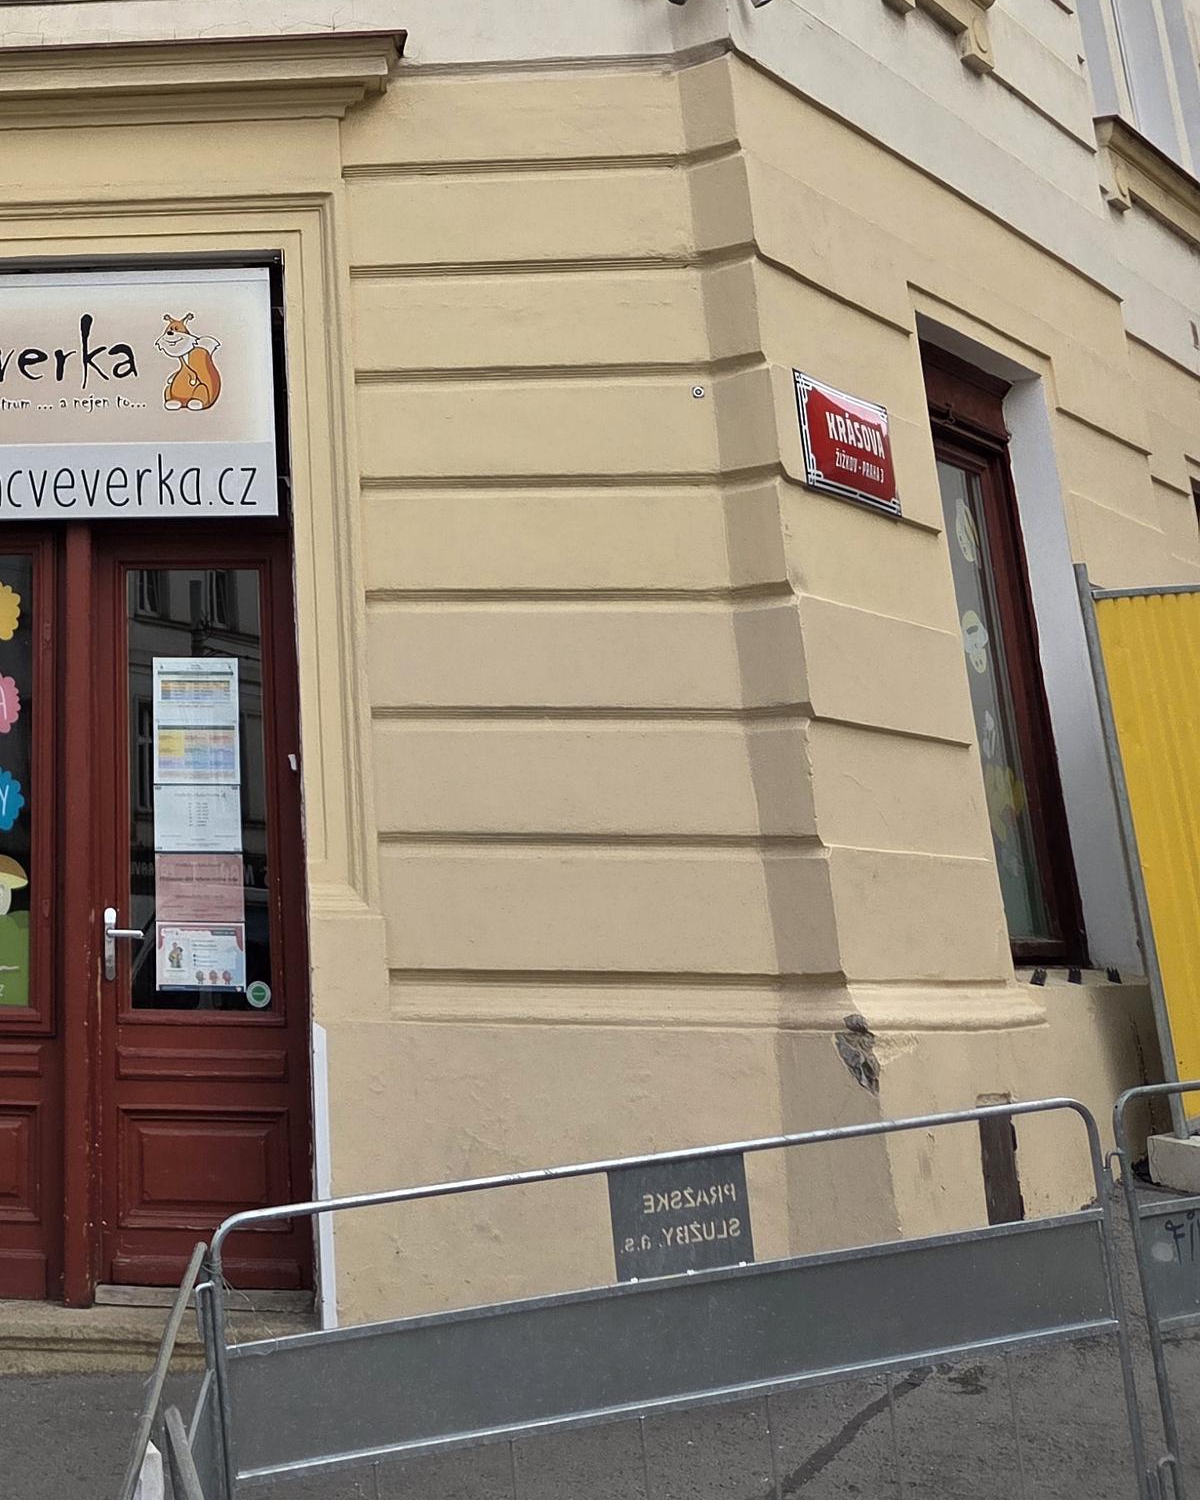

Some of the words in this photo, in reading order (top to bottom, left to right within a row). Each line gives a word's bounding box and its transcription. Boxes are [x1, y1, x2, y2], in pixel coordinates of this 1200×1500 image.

[60, 399, 67, 408] a
[73, 395, 110, 413] nejen
[826, 412, 885, 459] KRÁSOVA
[835, 447, 857, 473] ŽIŽKOV
[862, 460, 880, 482] PRAHA
[880, 468, 884, 484] 3
